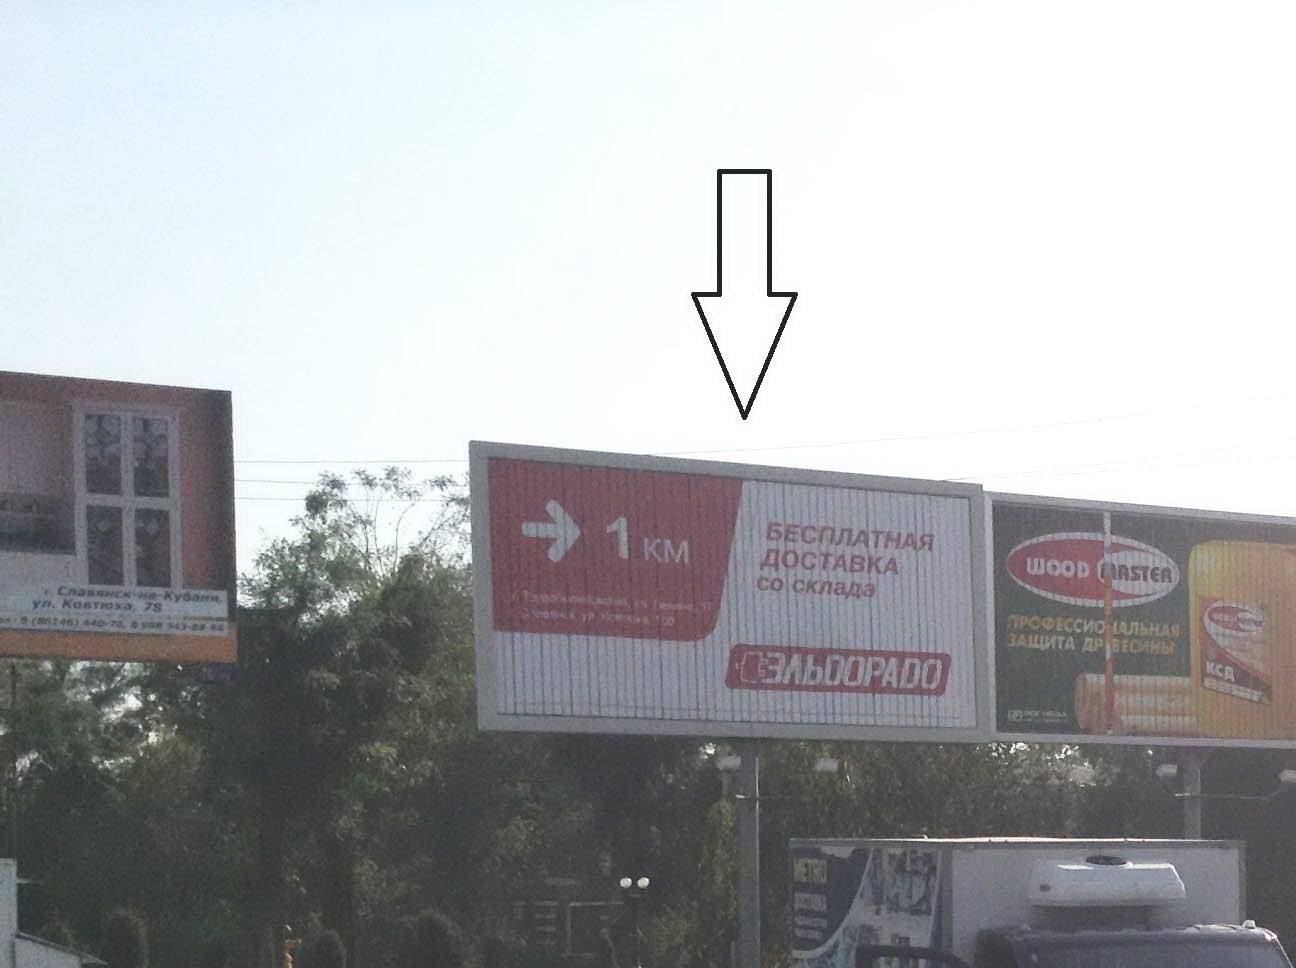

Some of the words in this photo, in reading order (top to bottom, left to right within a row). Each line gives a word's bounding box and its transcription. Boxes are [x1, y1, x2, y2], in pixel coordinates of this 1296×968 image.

[606, 516, 630, 560] 1
[766, 521, 934, 551] БЕСПЛАТНАЯ
[760, 549, 899, 575] ДОСТАВКА
[1026, 557, 1090, 579] WOOD
[756, 577, 784, 592] со
[792, 579, 876, 599] склада
[32, 600, 56, 611] ул.
[1008, 632, 1076, 651] ЗАЩИТА
[1081, 637, 1176, 655] ДРВЕСИНЫ
